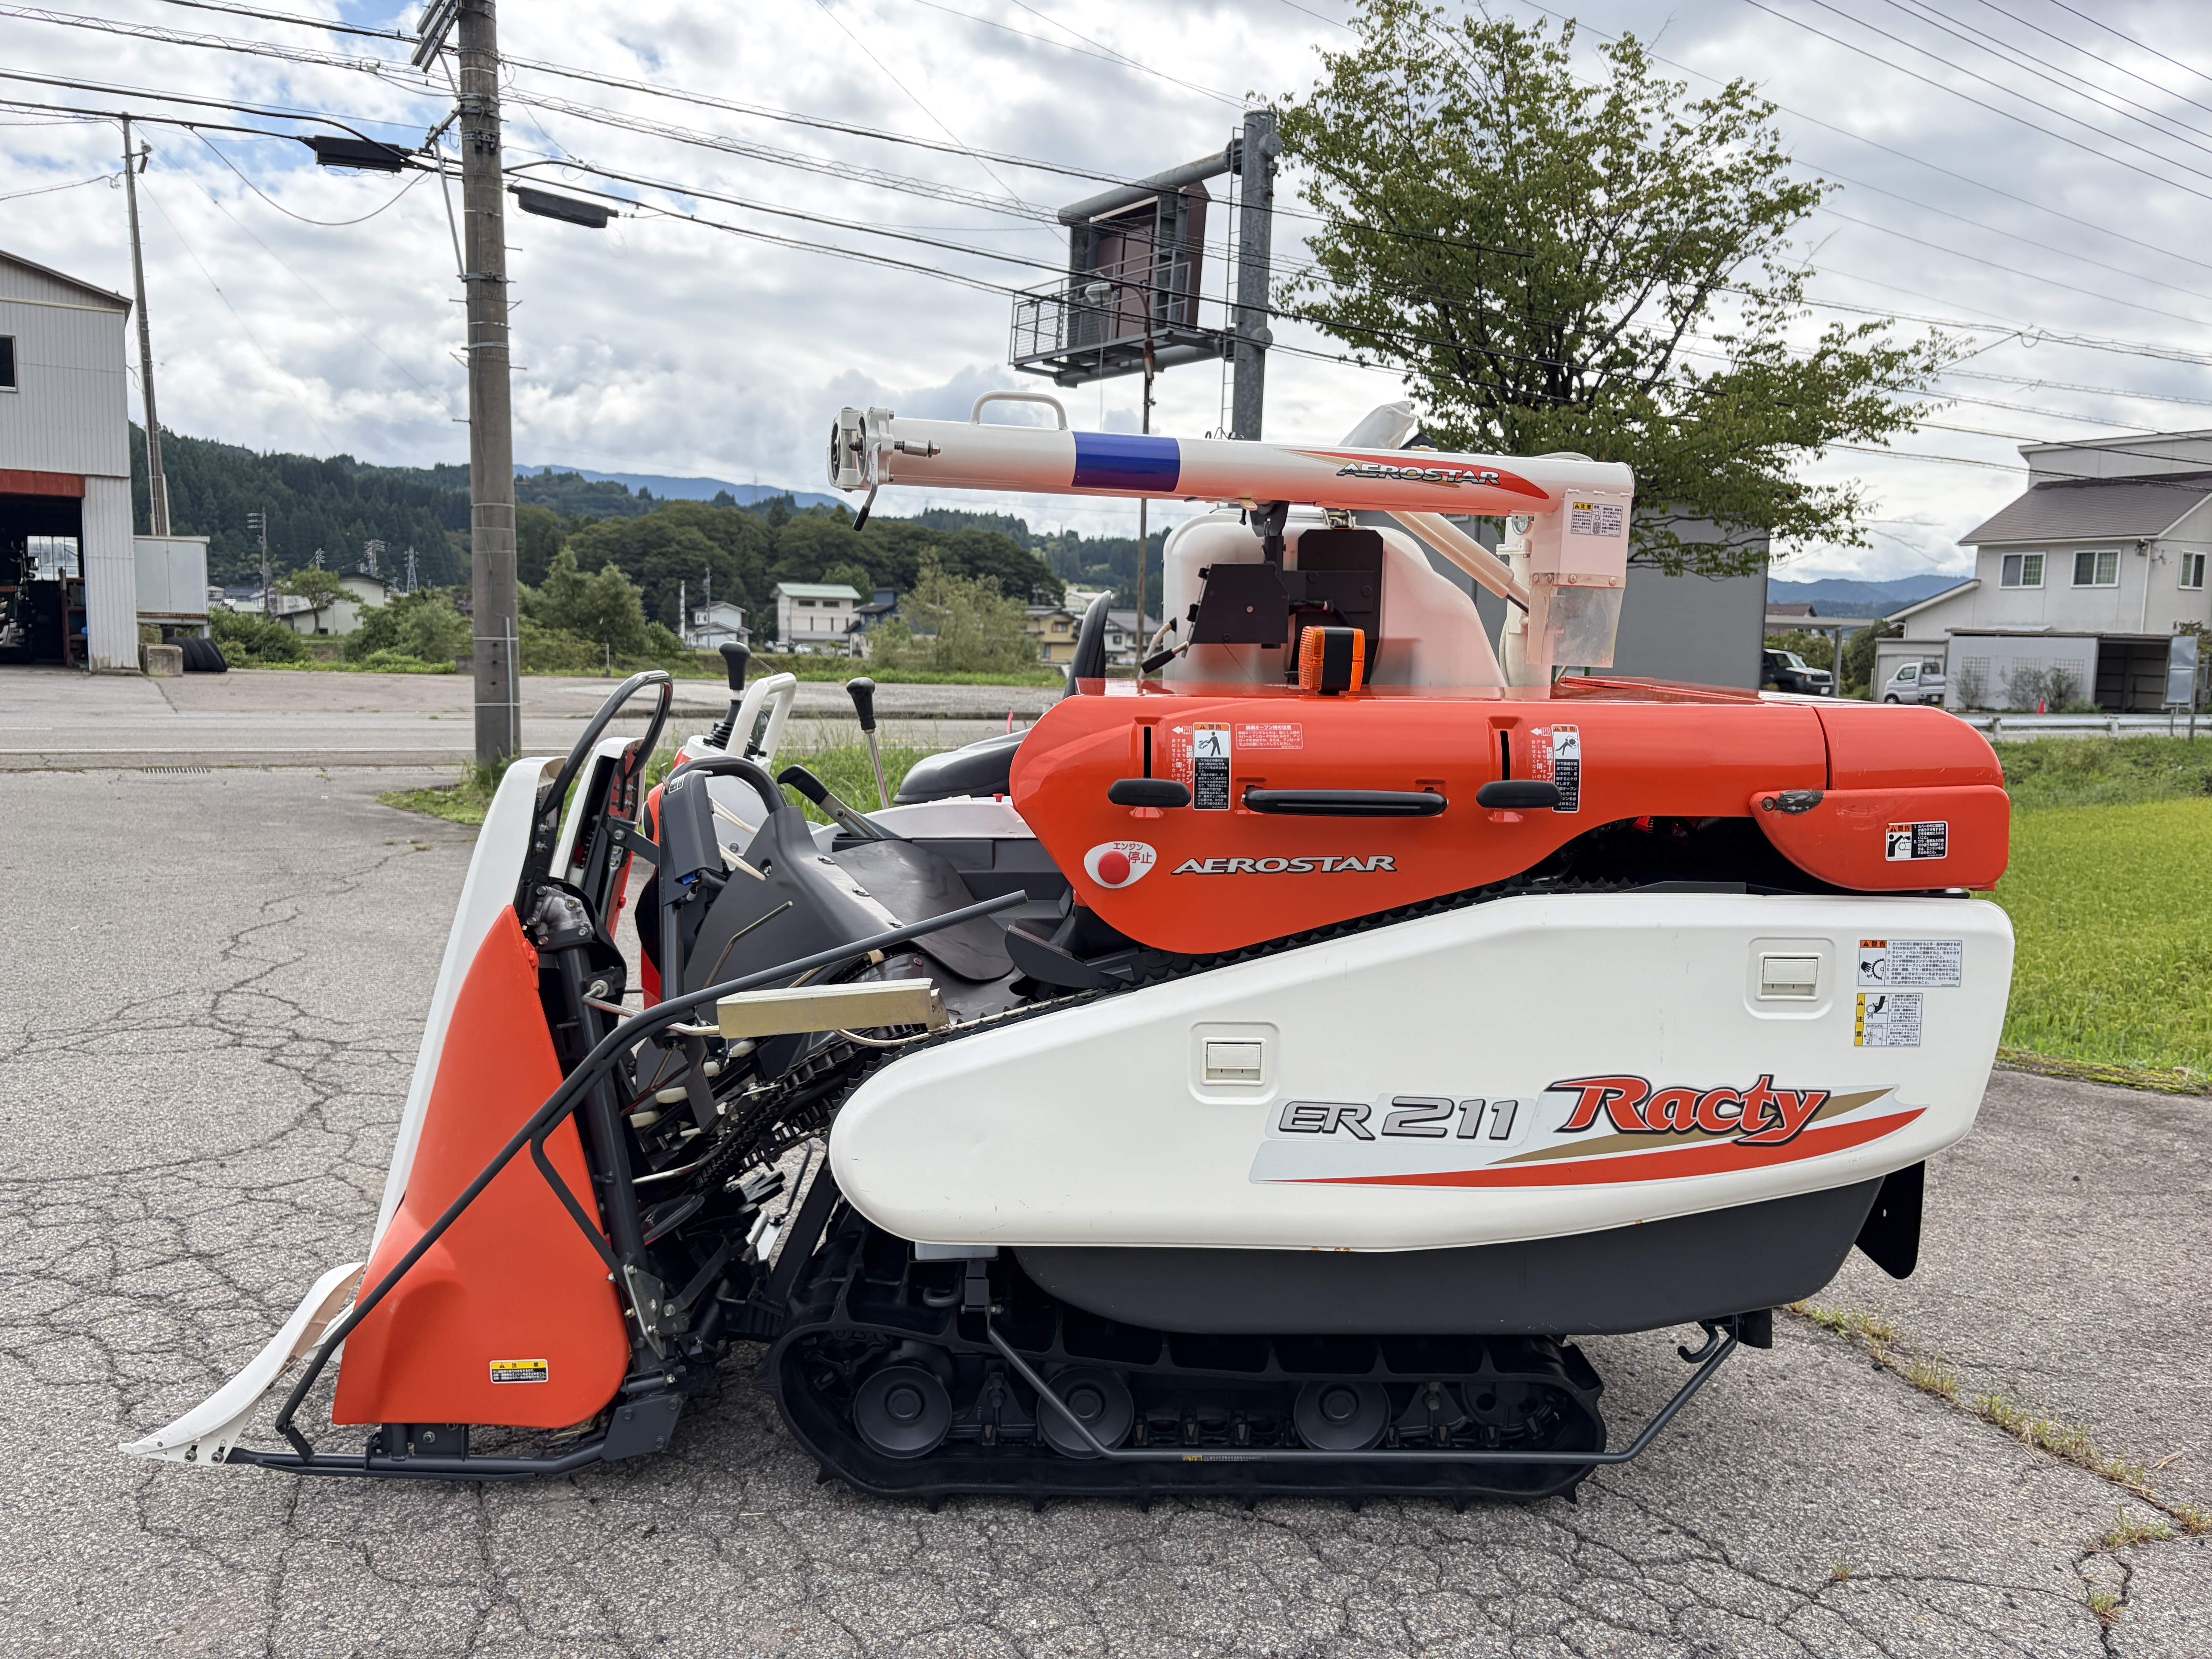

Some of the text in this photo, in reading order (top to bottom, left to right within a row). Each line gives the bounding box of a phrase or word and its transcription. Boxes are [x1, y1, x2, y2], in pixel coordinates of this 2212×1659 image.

[1336, 463, 1501, 485] AEROSTAR
[1128, 851, 1153, 864] 停止
[1171, 855, 1398, 875] AEROSTAR
[1279, 1096, 1518, 1140] ER 211
[1544, 1074, 1831, 1146] Racty
